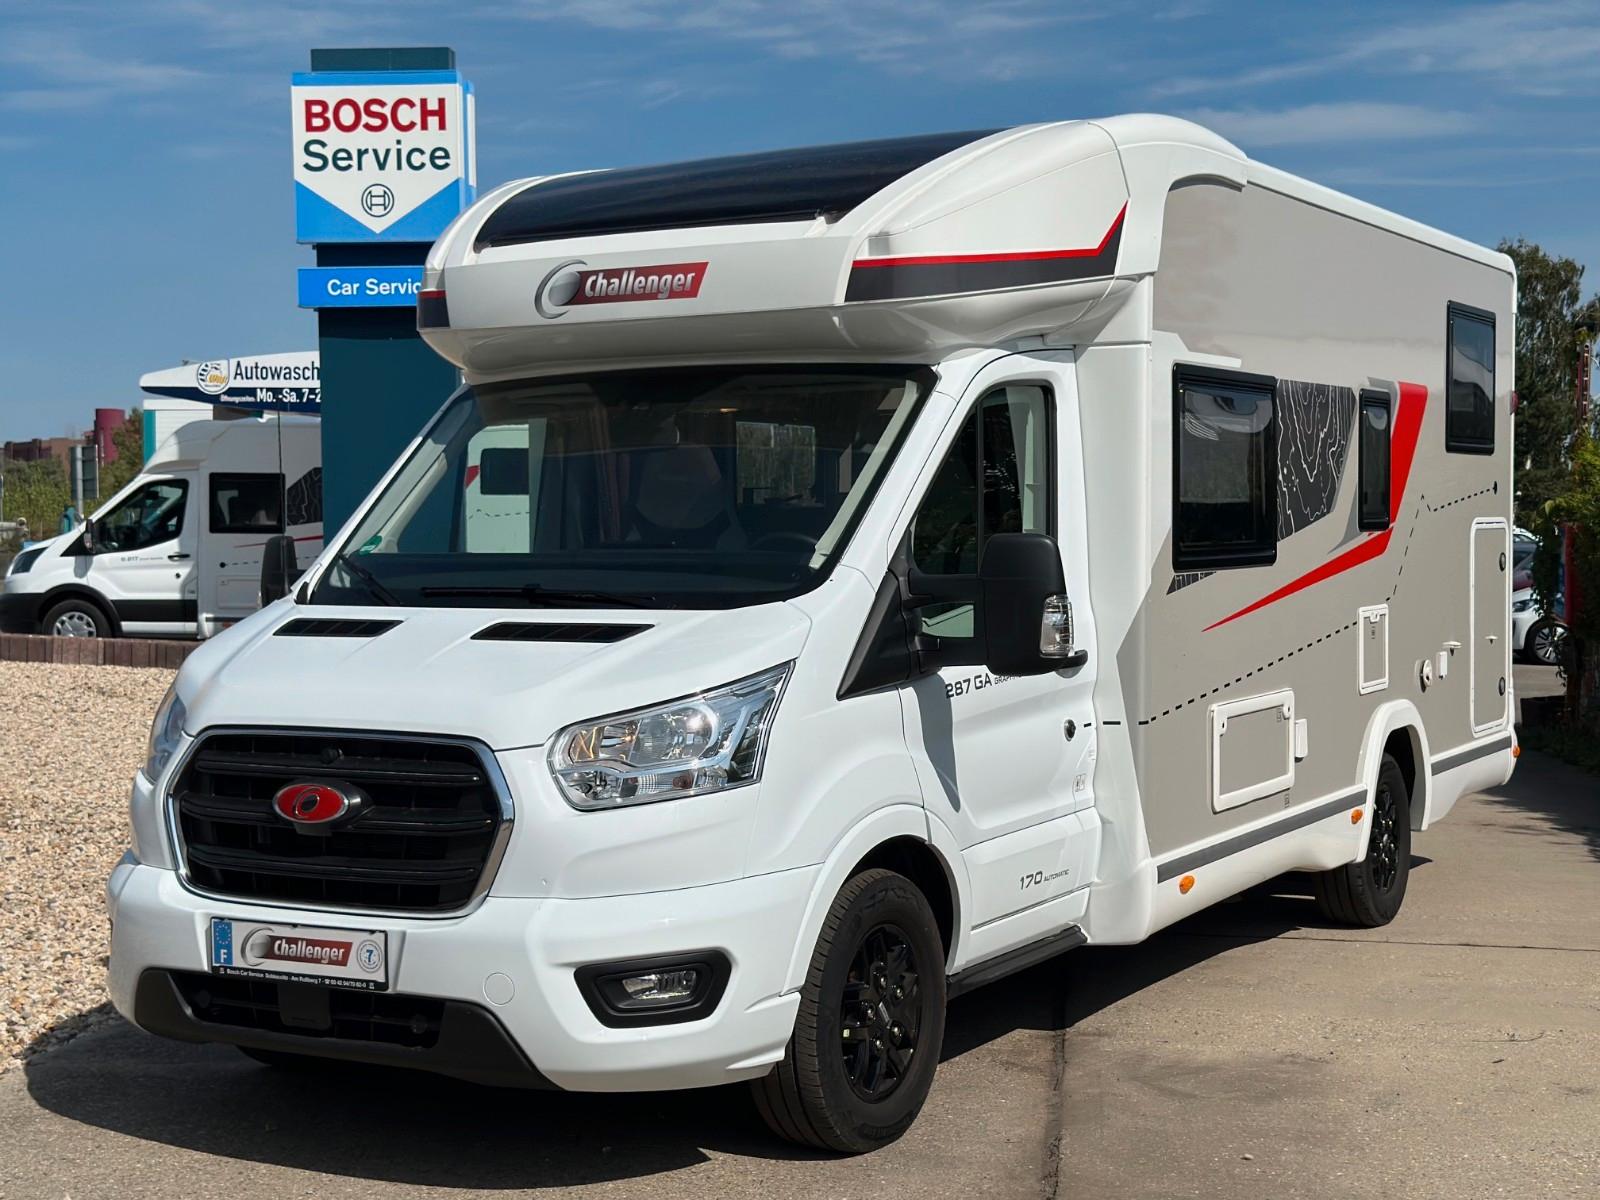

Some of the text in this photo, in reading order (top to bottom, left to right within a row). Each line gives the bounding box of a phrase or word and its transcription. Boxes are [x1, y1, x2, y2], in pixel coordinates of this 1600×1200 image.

[304, 98, 447, 133] BOSCH
[302, 139, 451, 172] Service
[327, 277, 422, 296] Car Servic
[584, 270, 696, 299] Challenger
[233, 360, 320, 381] Autowasch
[256, 388, 276, 403] Mo.
[945, 678, 971, 699] 287
[974, 672, 992, 691] GA
[1019, 870, 1043, 891] 170
[219, 949, 228, 963] F
[273, 939, 345, 964] Challenger
